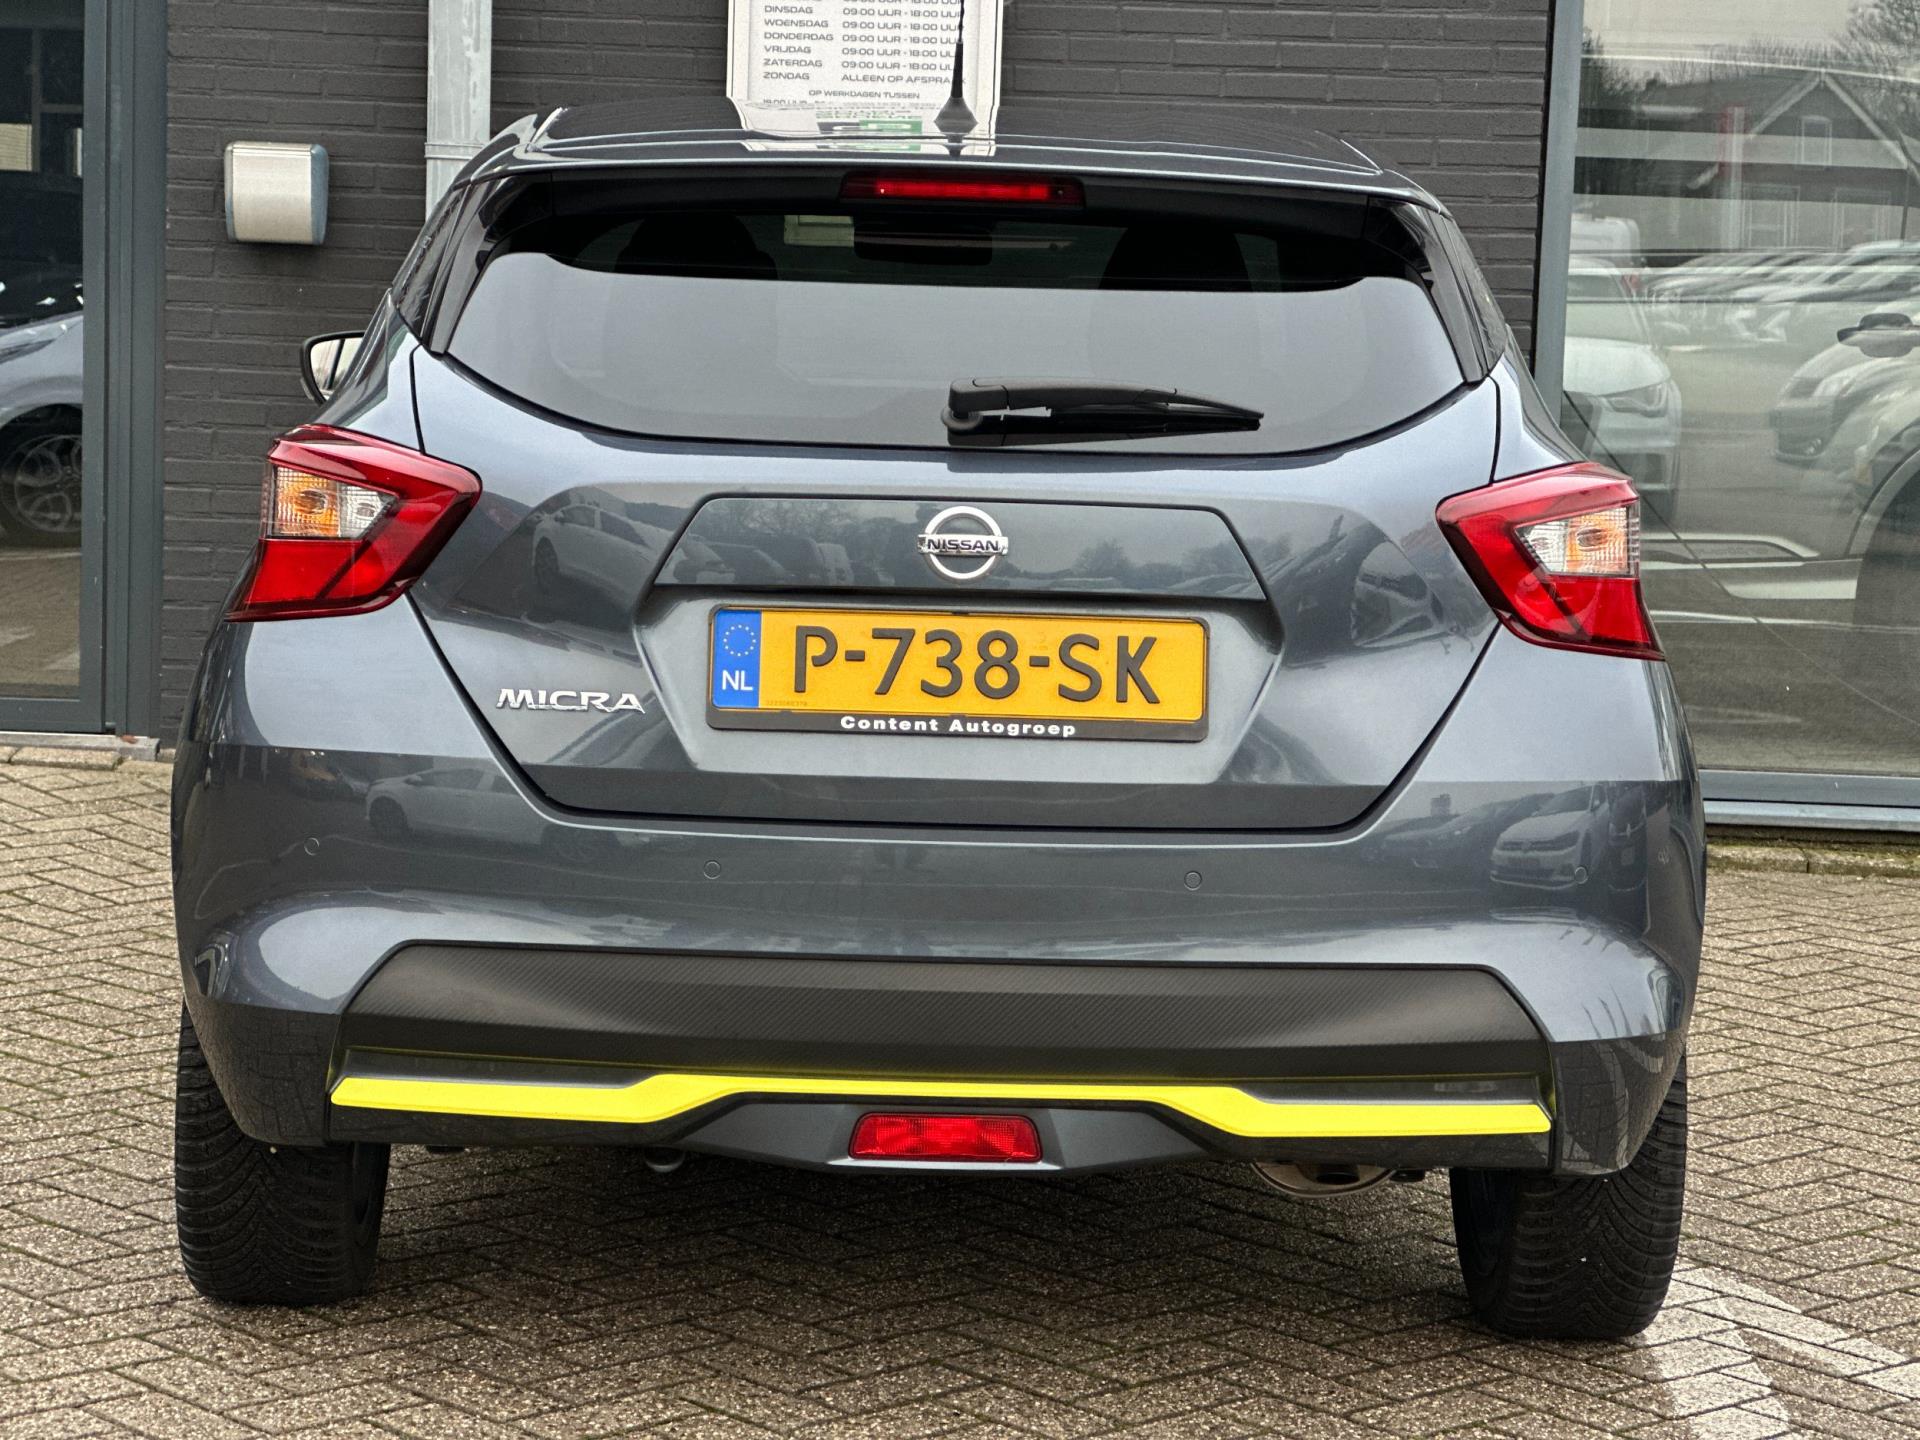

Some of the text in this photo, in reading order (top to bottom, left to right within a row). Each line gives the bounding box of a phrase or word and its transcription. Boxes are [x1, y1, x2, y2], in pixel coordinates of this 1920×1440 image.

[765, 5, 813, 14] DINSDAG
[843, 8, 875, 16] 09:00
[764, 19, 828, 27] WOENSDAG
[843, 21, 874, 29] 09:00
[764, 32, 834, 41] DONDERDAG
[764, 46, 811, 54] VRIJDAG
[764, 58, 822, 67] ZATERDAG
[842, 61, 873, 69] 09:00
[763, 72, 809, 80] ZONDAG
[842, 74, 884, 82] ALLEEN
[927, 539, 999, 551] NISSAN
[794, 625, 1160, 704] P-738-SK
[722, 670, 753, 691] NL
[496, 689, 646, 714] MICRA
[840, 716, 1077, 738] Content Autogroep
